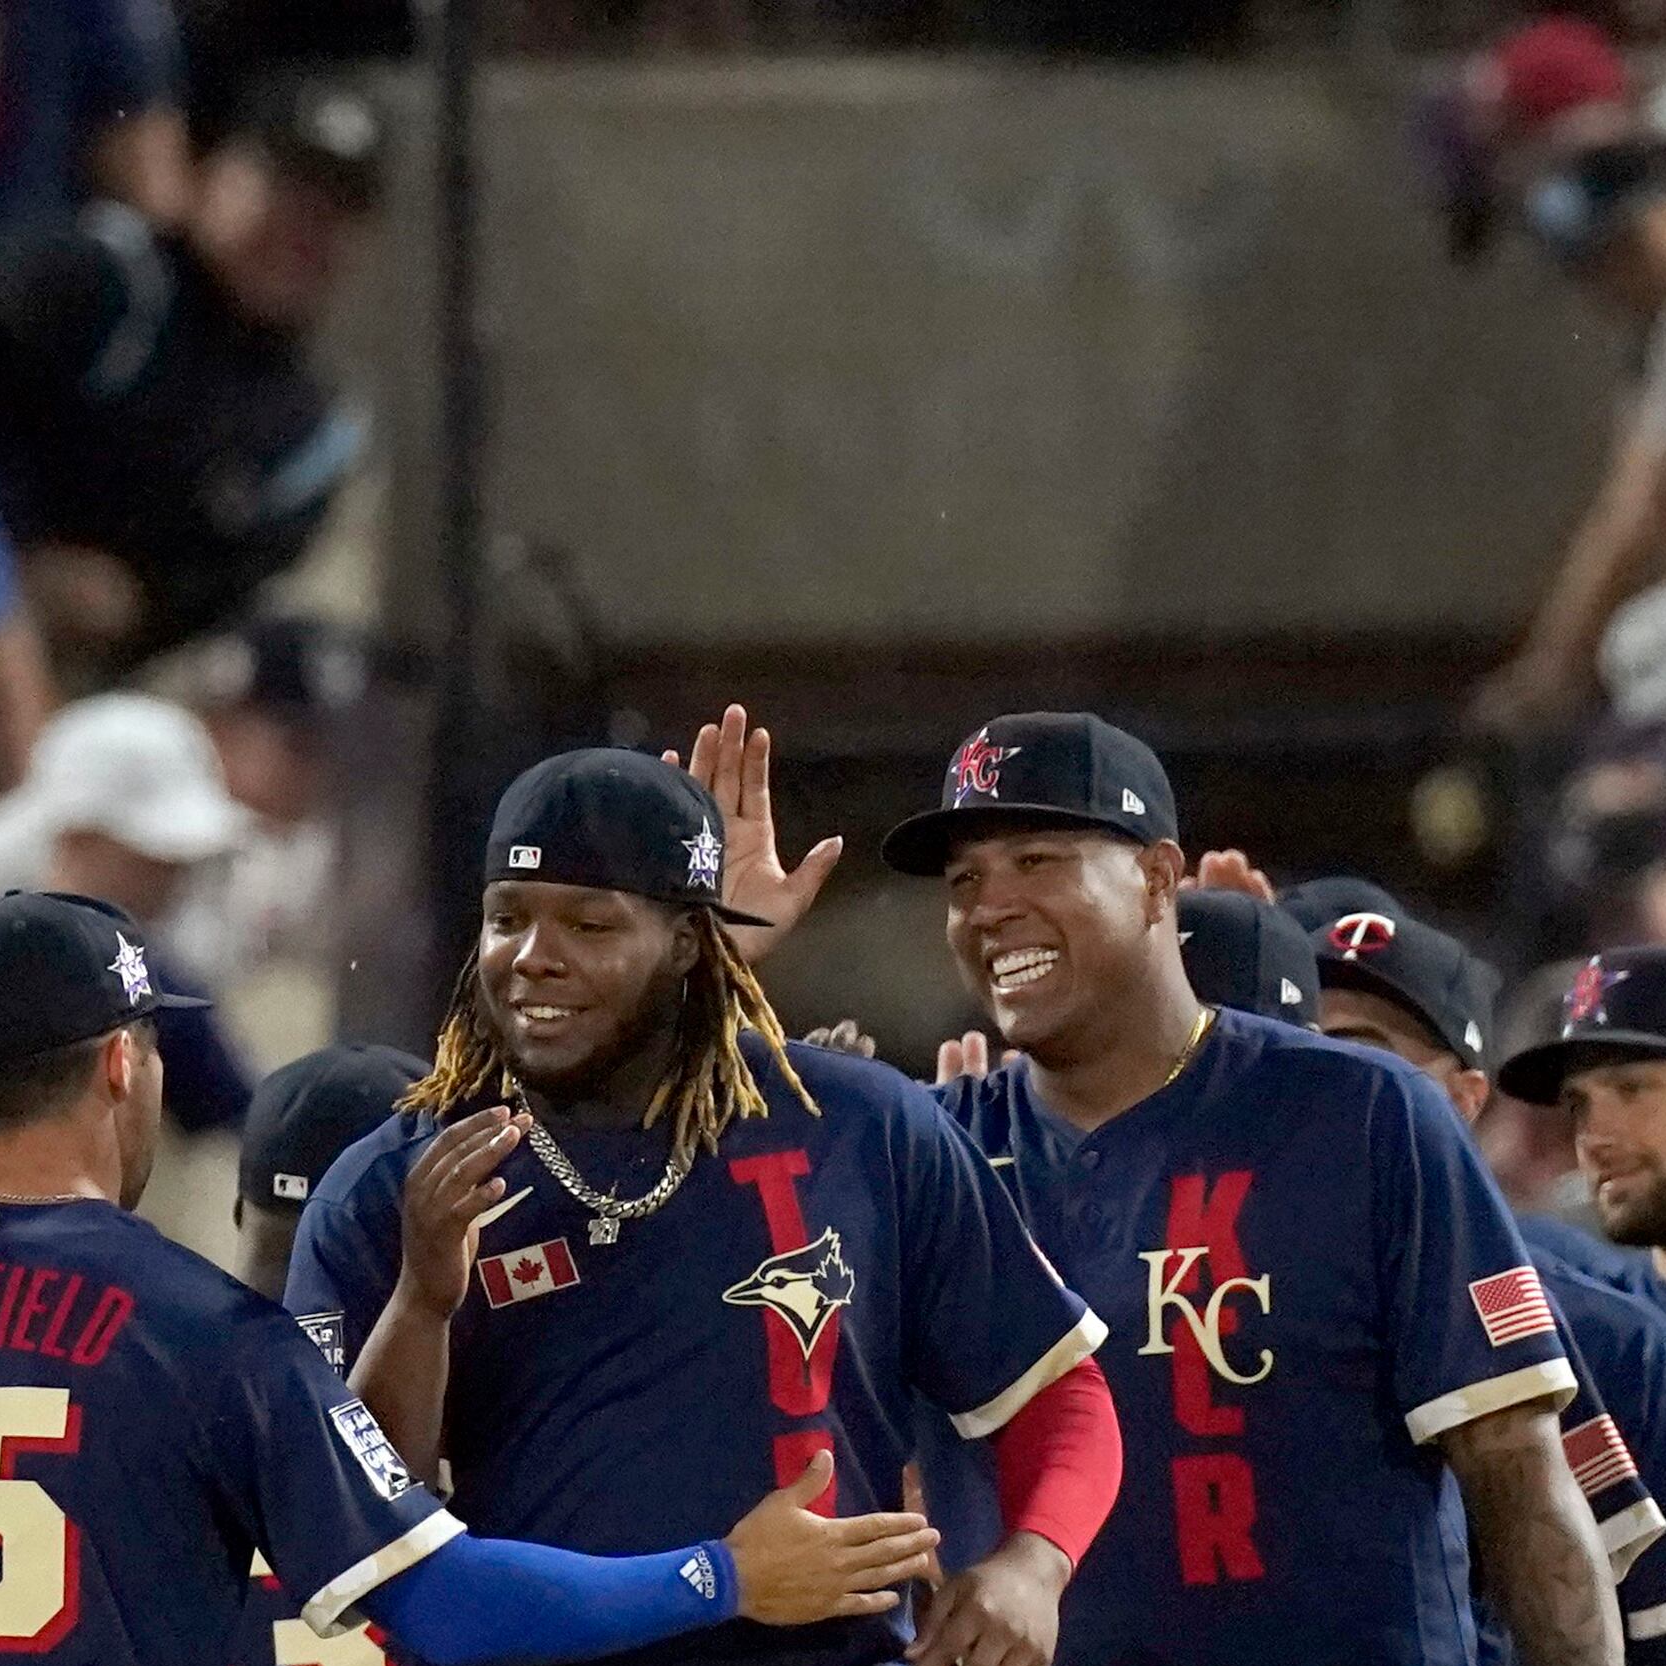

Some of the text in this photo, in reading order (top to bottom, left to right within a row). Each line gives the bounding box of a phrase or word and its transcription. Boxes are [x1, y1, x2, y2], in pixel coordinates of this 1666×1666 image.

[688, 847, 719, 872] ASG
[1137, 1245, 1274, 1384] KC
[695, 1549, 716, 1600] adidas
